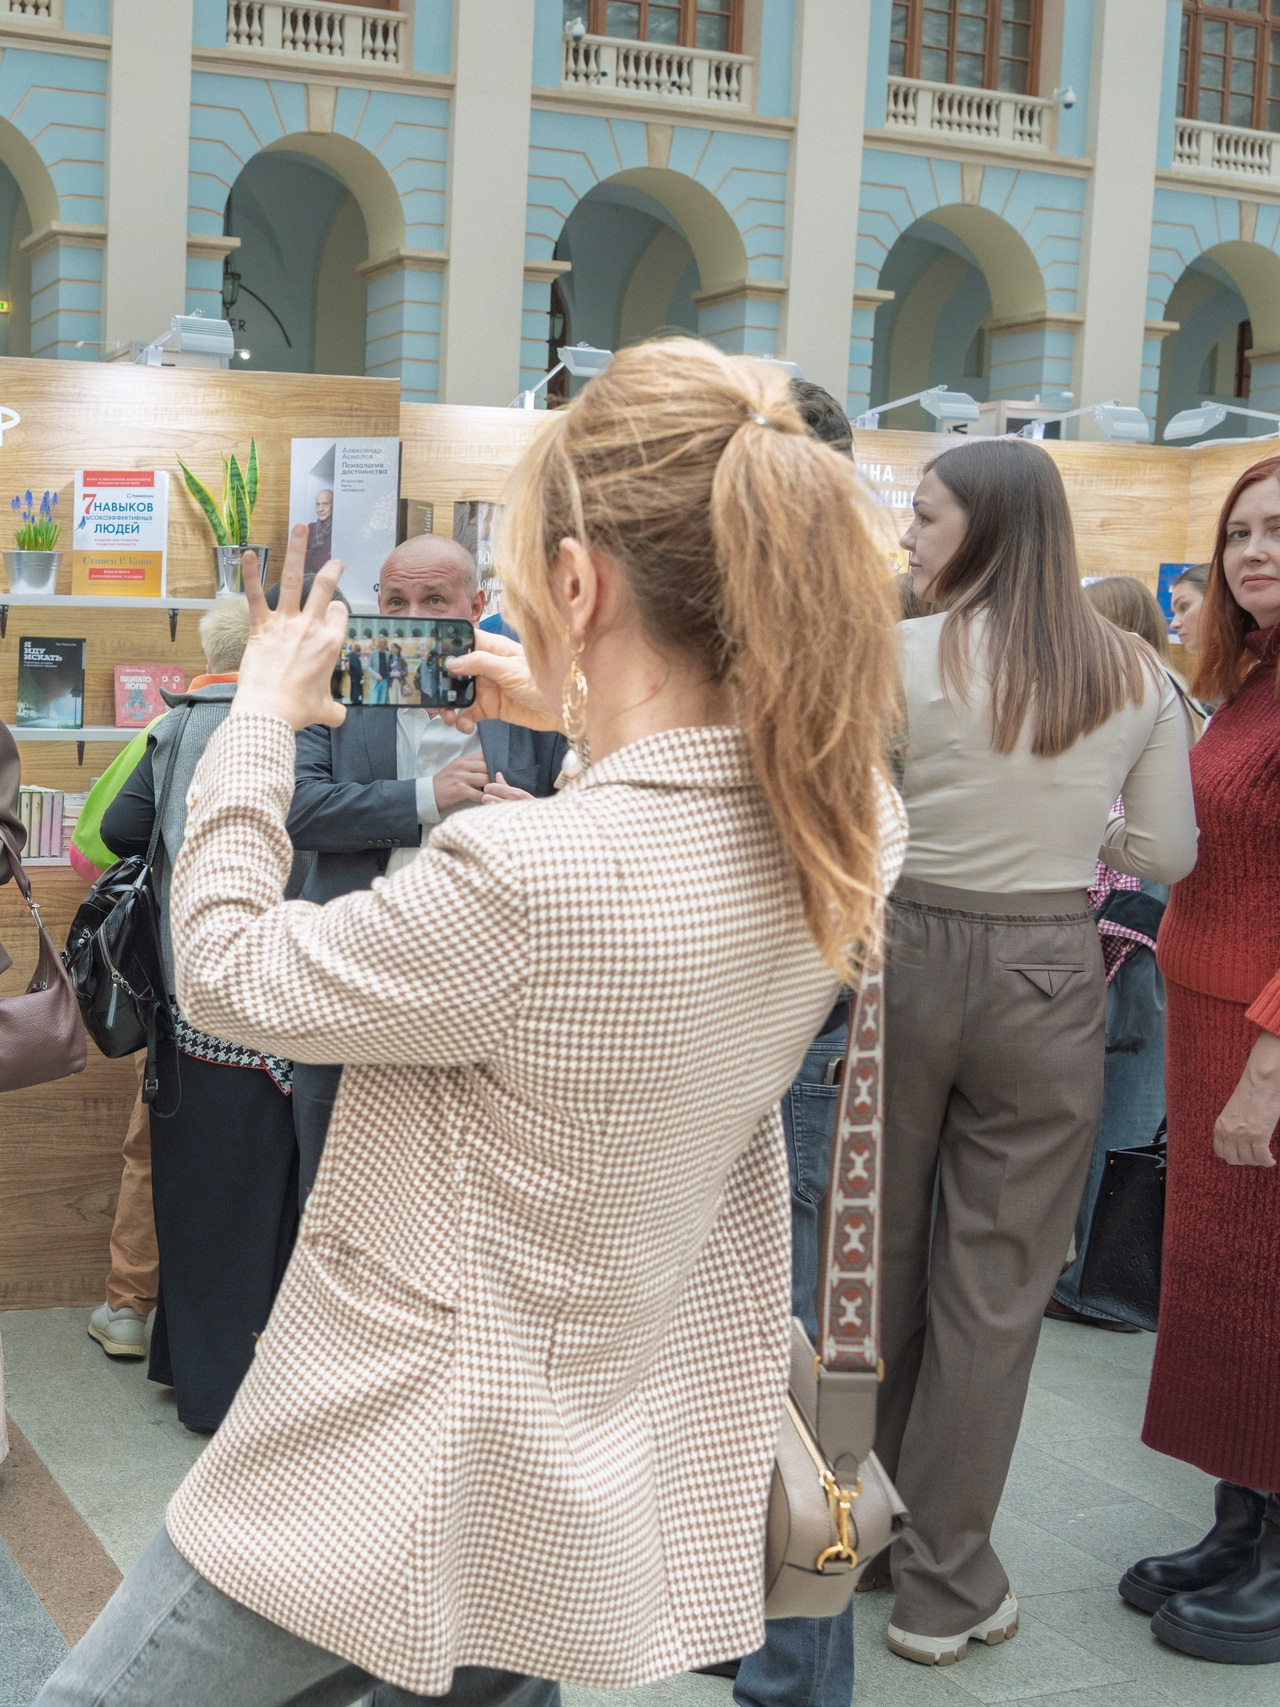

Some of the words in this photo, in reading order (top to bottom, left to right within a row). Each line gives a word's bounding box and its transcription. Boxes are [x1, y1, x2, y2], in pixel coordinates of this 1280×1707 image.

[341, 461, 384, 469] Психология
[82, 494, 96, 515] 7
[94, 502, 154, 512] НАВЫКОВ
[94, 522, 140, 535] ЛЮДЕЙ
[23, 647, 46, 655] ИДУ
[23, 654, 63, 662] ИСКАТЬ
